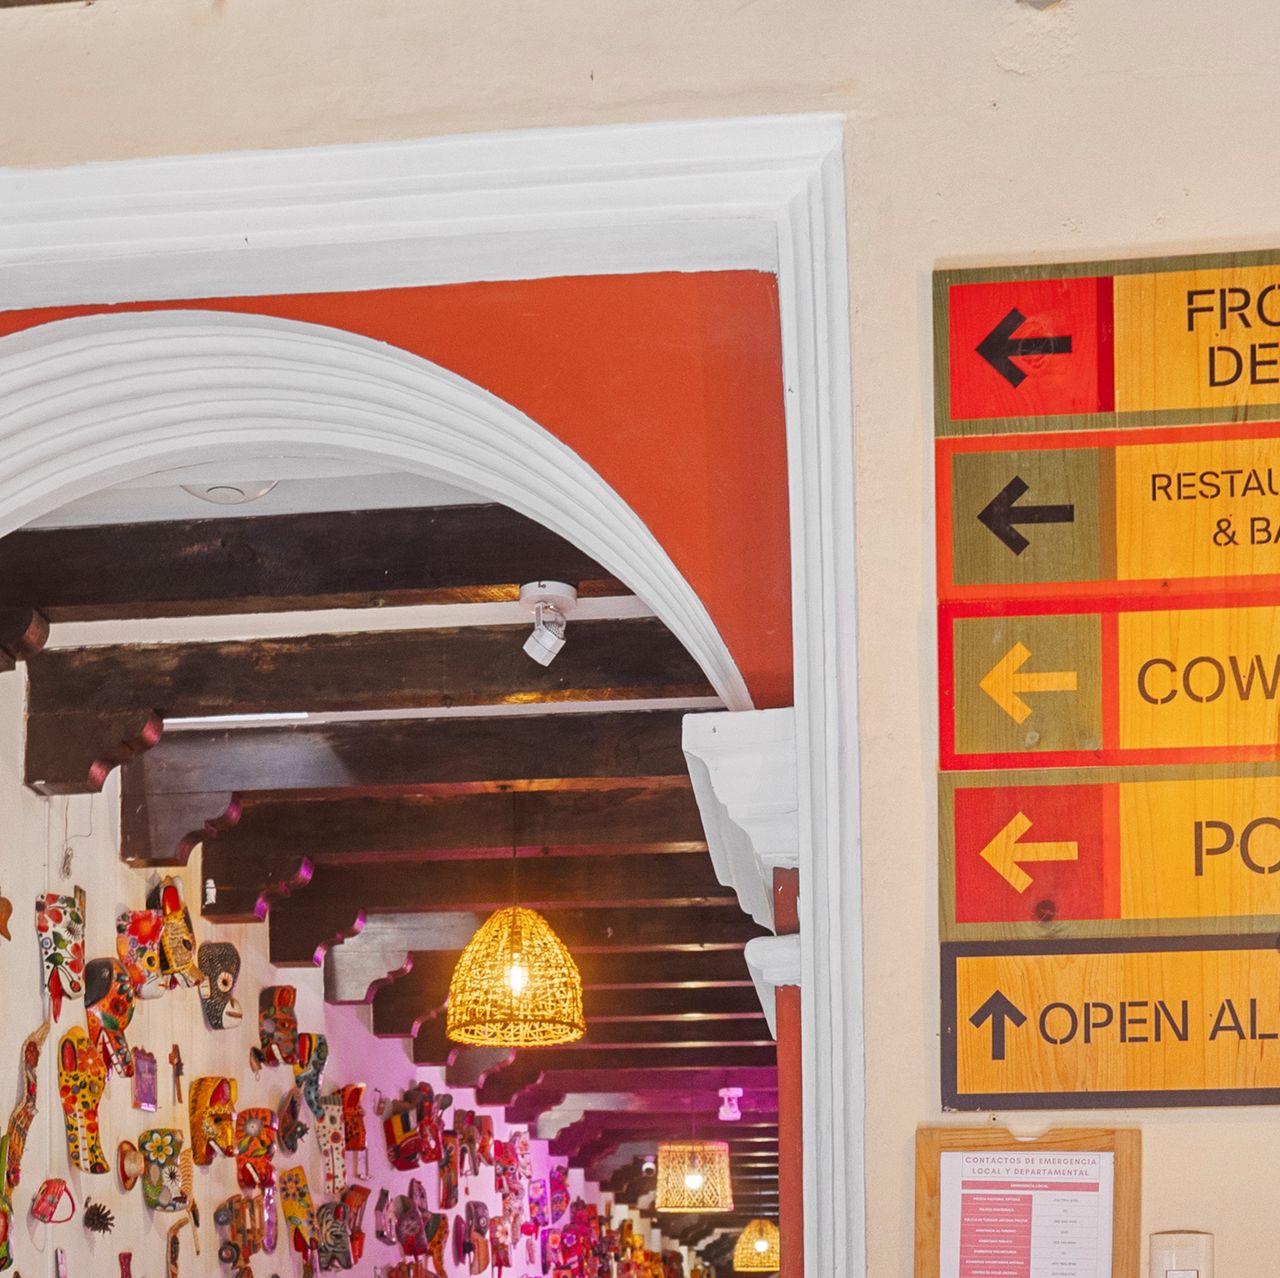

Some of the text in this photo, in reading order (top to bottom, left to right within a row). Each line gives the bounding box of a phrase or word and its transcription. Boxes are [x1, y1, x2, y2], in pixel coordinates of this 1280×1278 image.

[1213, 518, 1239, 547] &
[1038, 1000, 1189, 1046] OPEN
[965, 1156, 1097, 1166] CONTACTOS DE EMERGENCIA
[972, 1167, 1002, 1175] LOCAL
[1014, 1168, 1089, 1176] DEPARTAMENTAL
